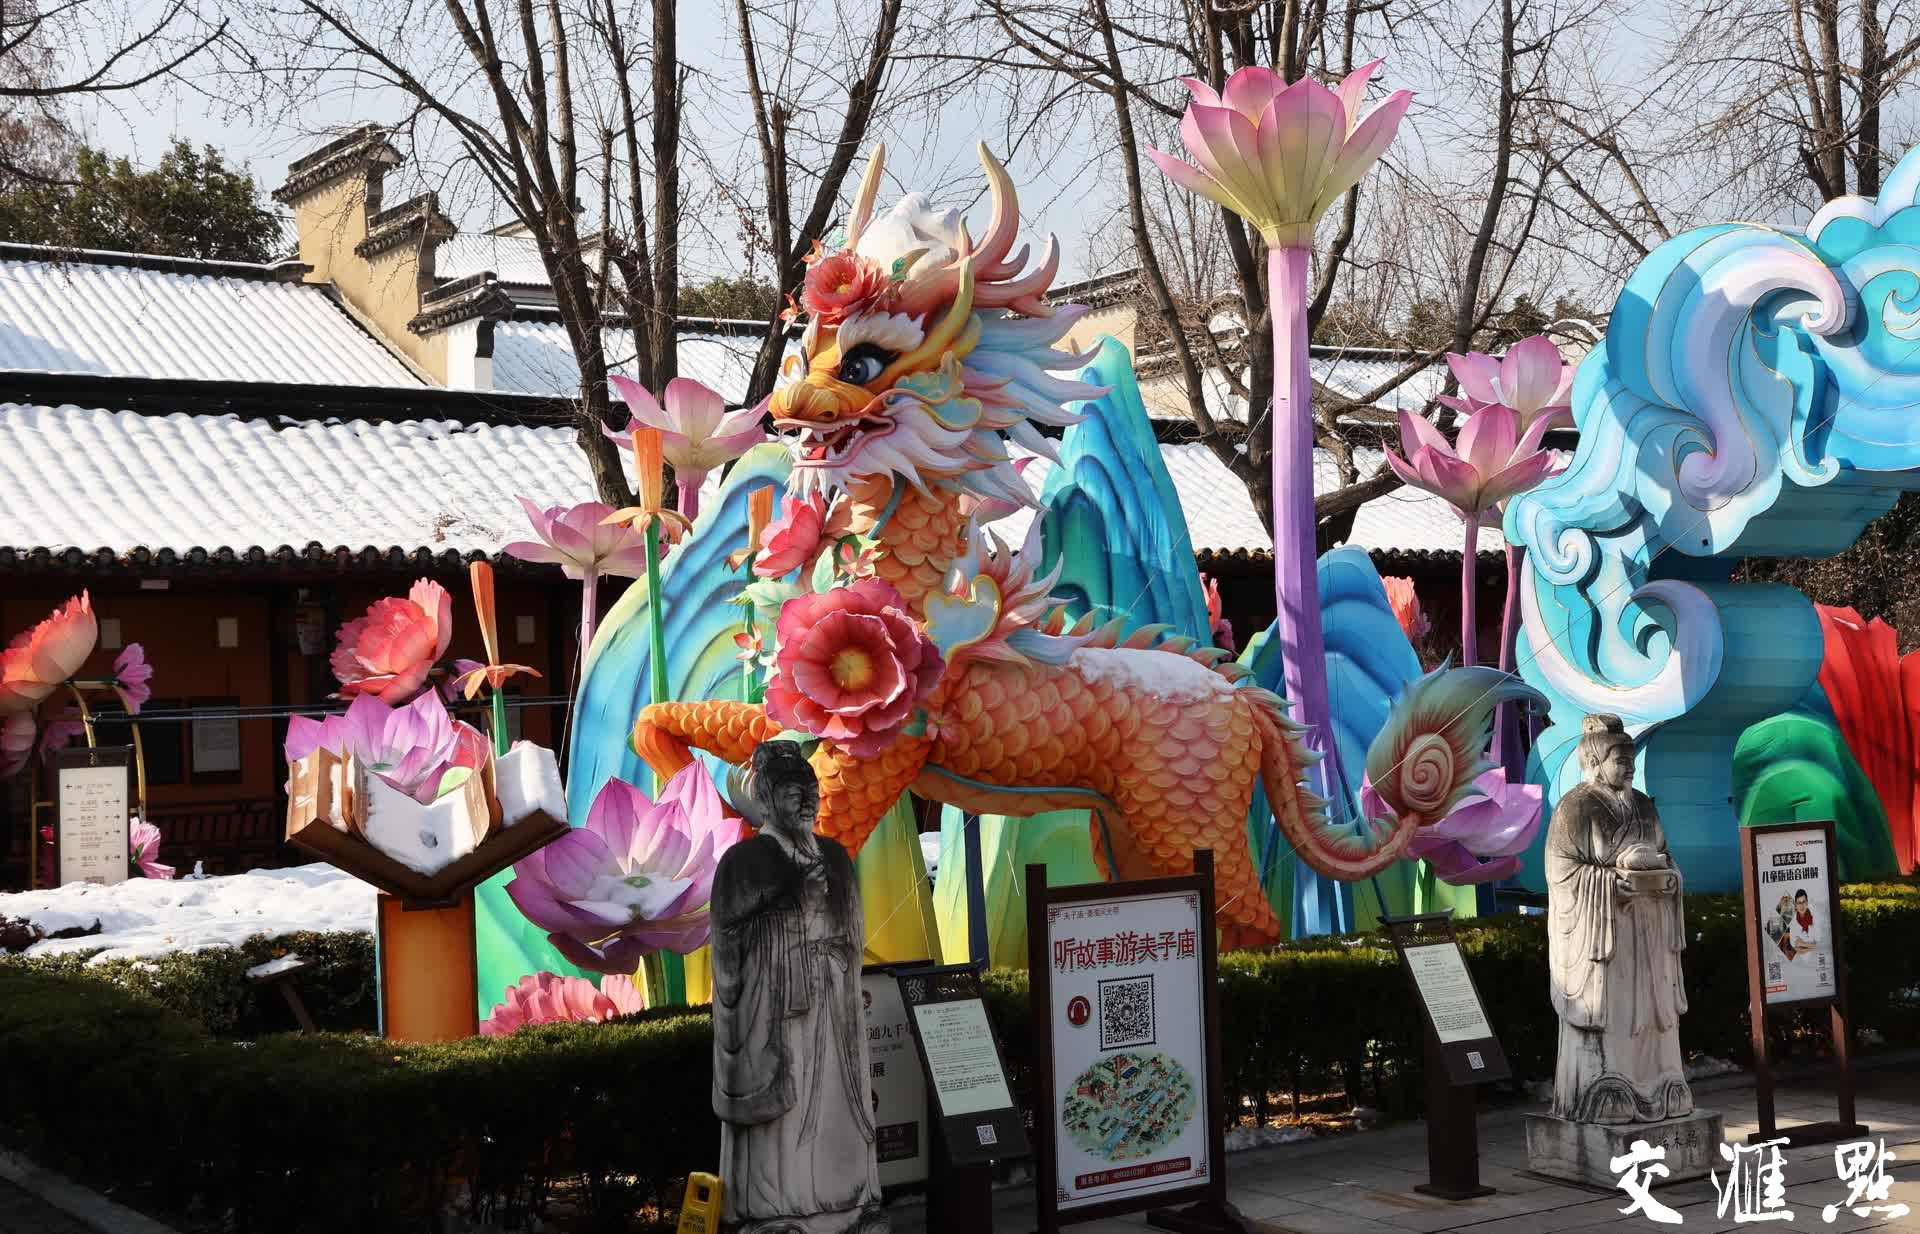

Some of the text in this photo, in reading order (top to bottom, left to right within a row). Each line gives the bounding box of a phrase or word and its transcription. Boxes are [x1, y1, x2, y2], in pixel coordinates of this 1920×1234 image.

[1762, 866, 1819, 884] 儿童版语音讲解
[1054, 928, 1196, 971] 听故事游夫子庙
